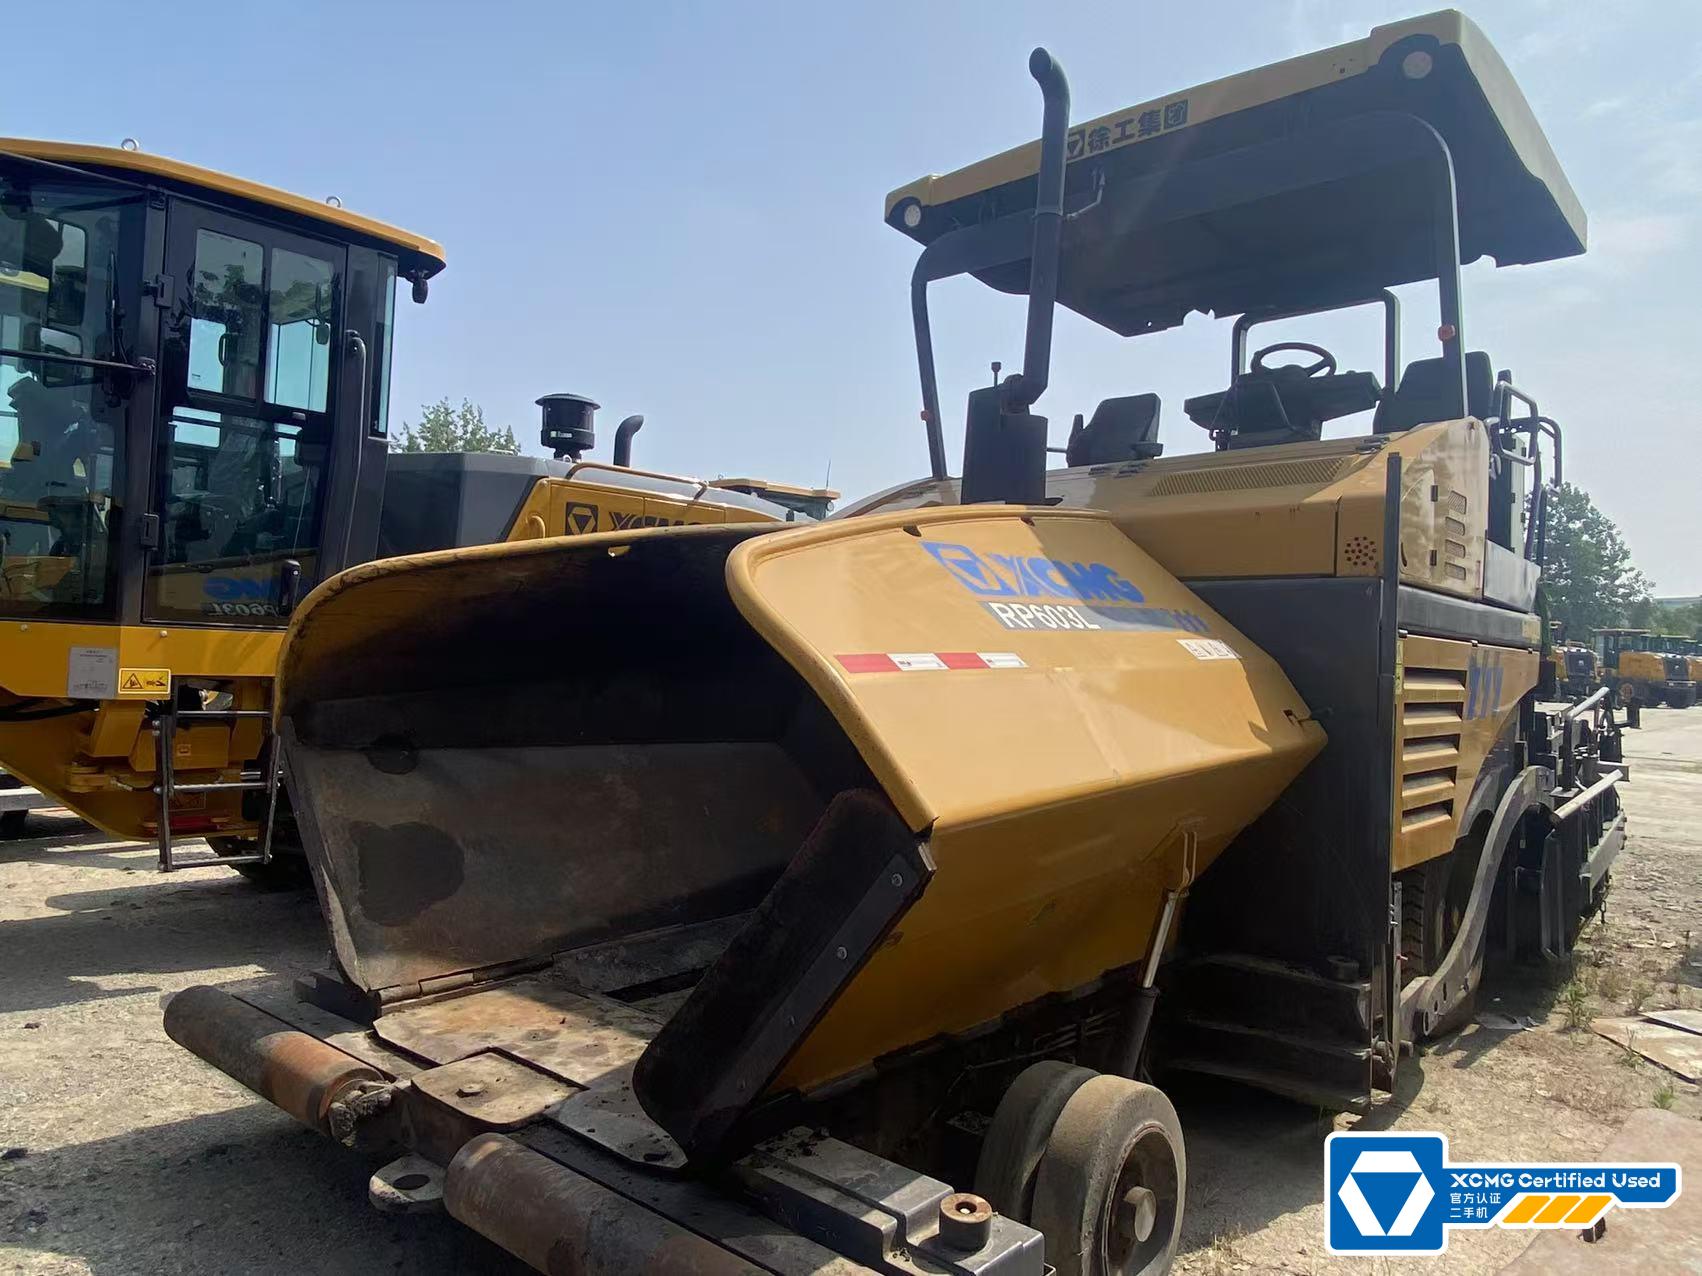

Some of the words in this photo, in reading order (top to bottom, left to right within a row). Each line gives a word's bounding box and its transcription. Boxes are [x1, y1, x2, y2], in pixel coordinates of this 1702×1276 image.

[1087, 99, 1189, 154] 徐工集团
[608, 511, 702, 531] XC
[986, 553, 1145, 604] XCMG
[988, 602, 1102, 629] RP603L
